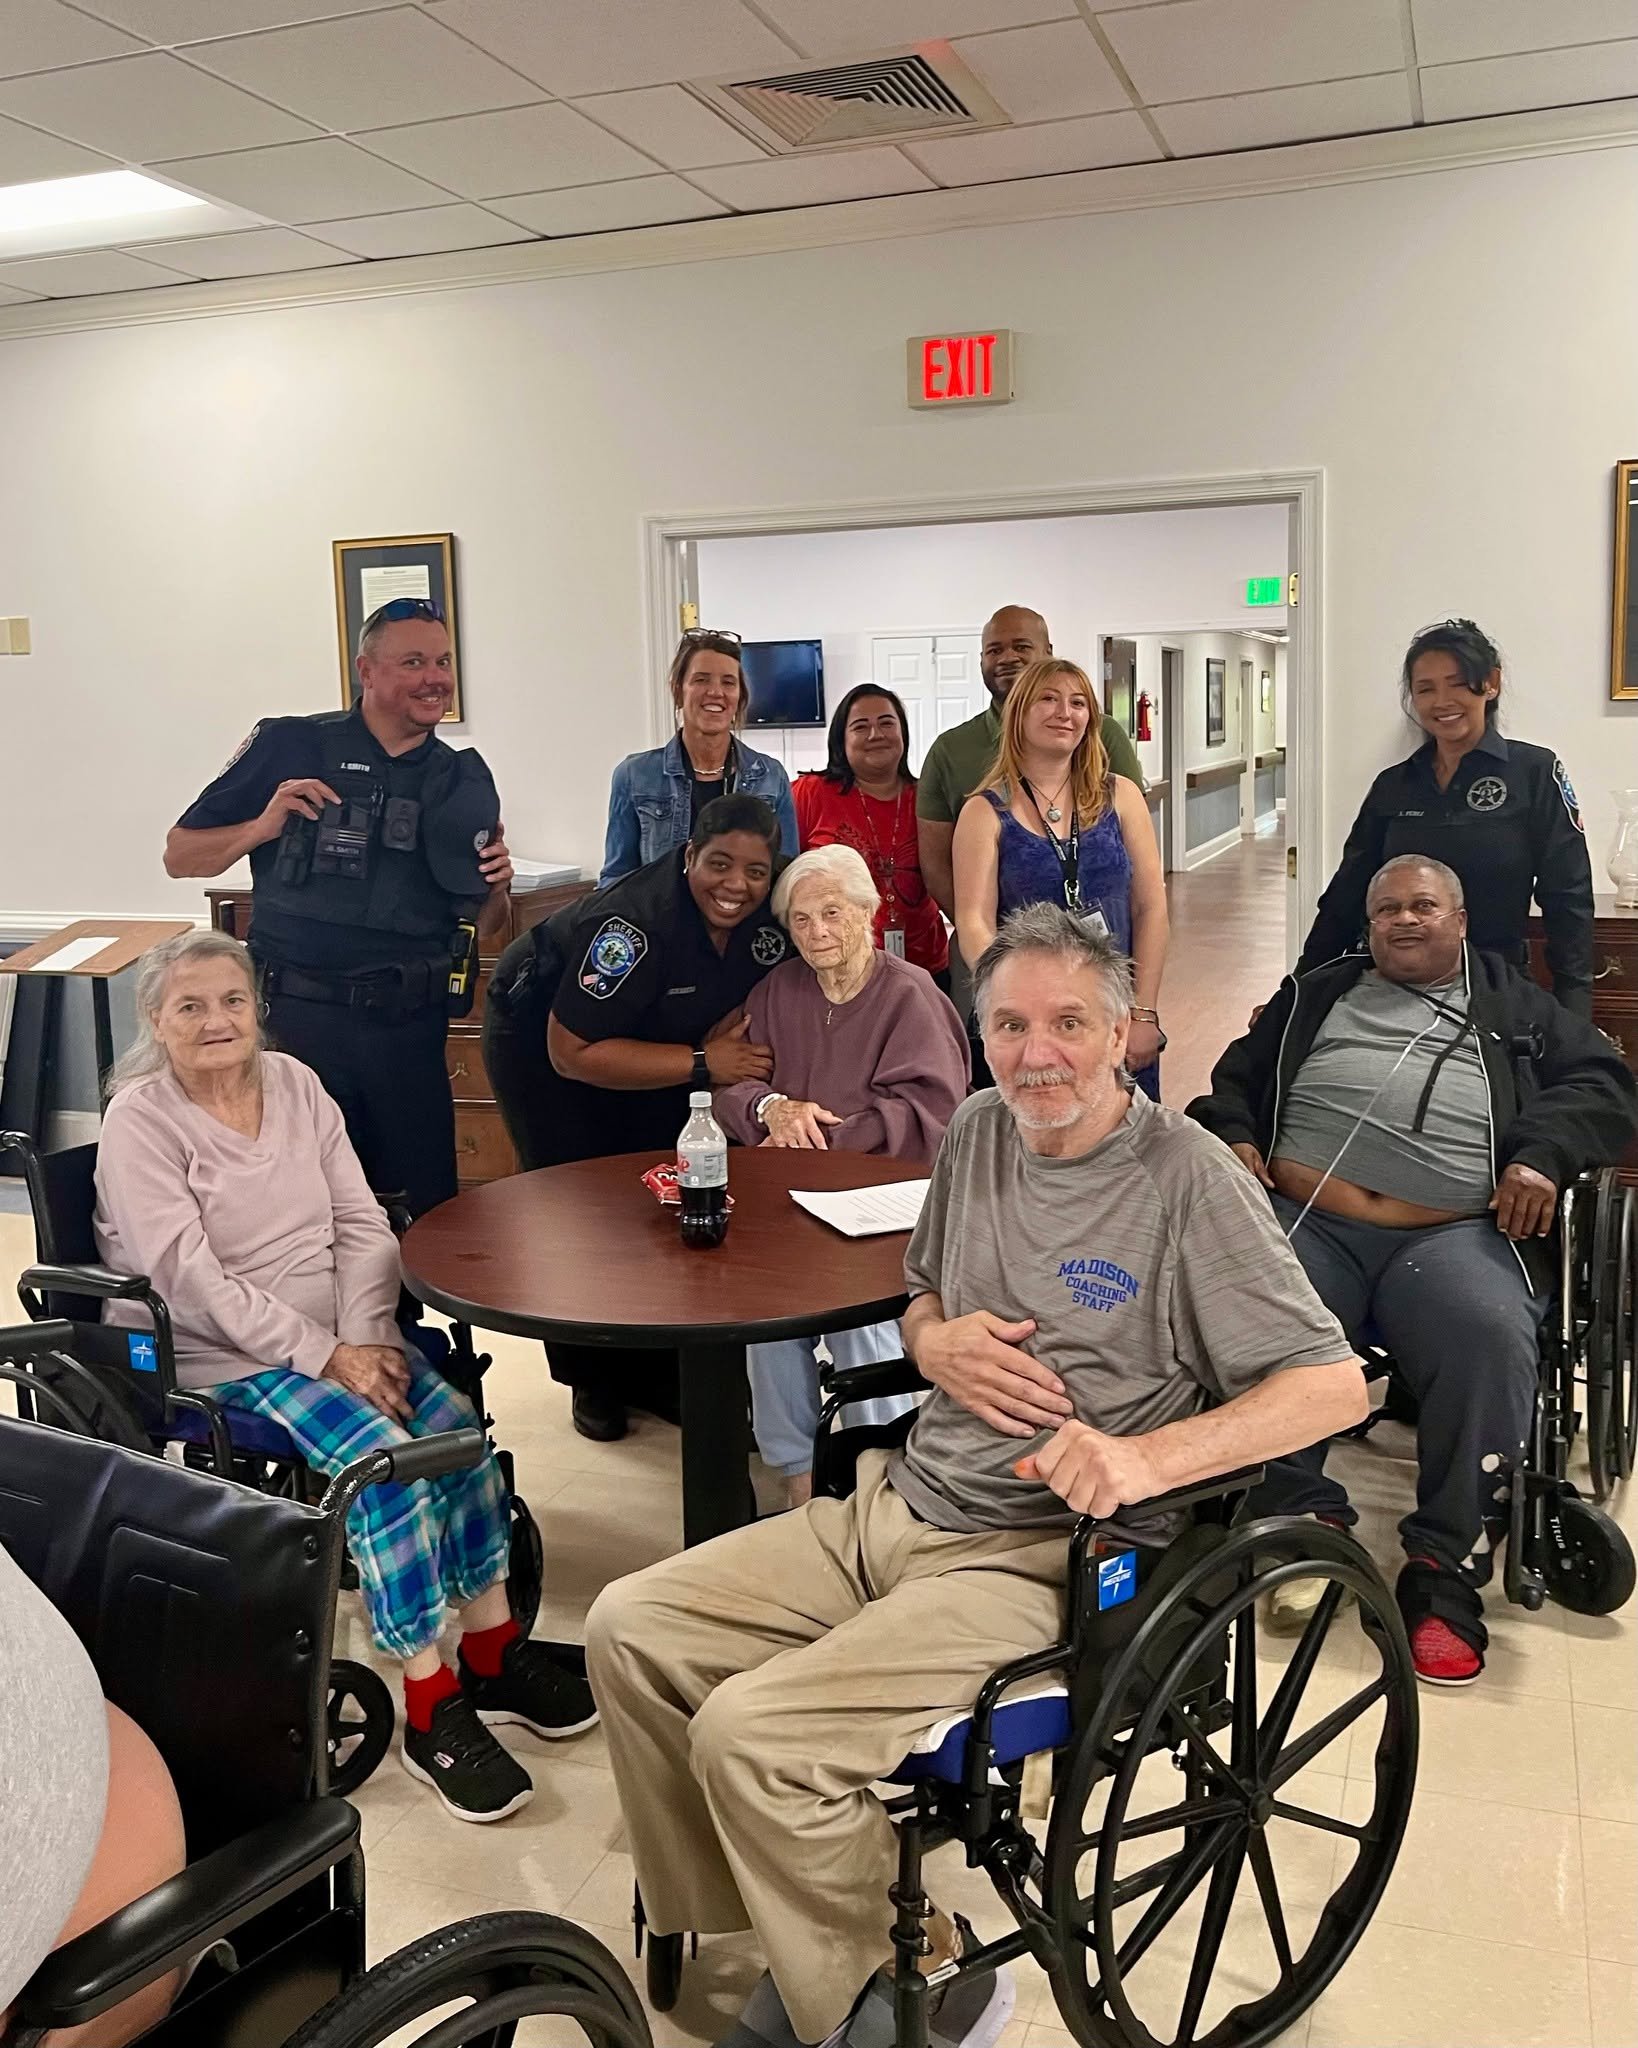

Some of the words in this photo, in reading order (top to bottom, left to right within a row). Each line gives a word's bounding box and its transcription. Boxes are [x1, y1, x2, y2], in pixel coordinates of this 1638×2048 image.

[923, 335, 996, 400] EXIT
[608, 923, 643, 949] SHERIFF
[1056, 1259, 1139, 1299] MADISON
[1065, 1276, 1127, 1303] COACHING
[1072, 1291, 1115, 1313] STAFF
